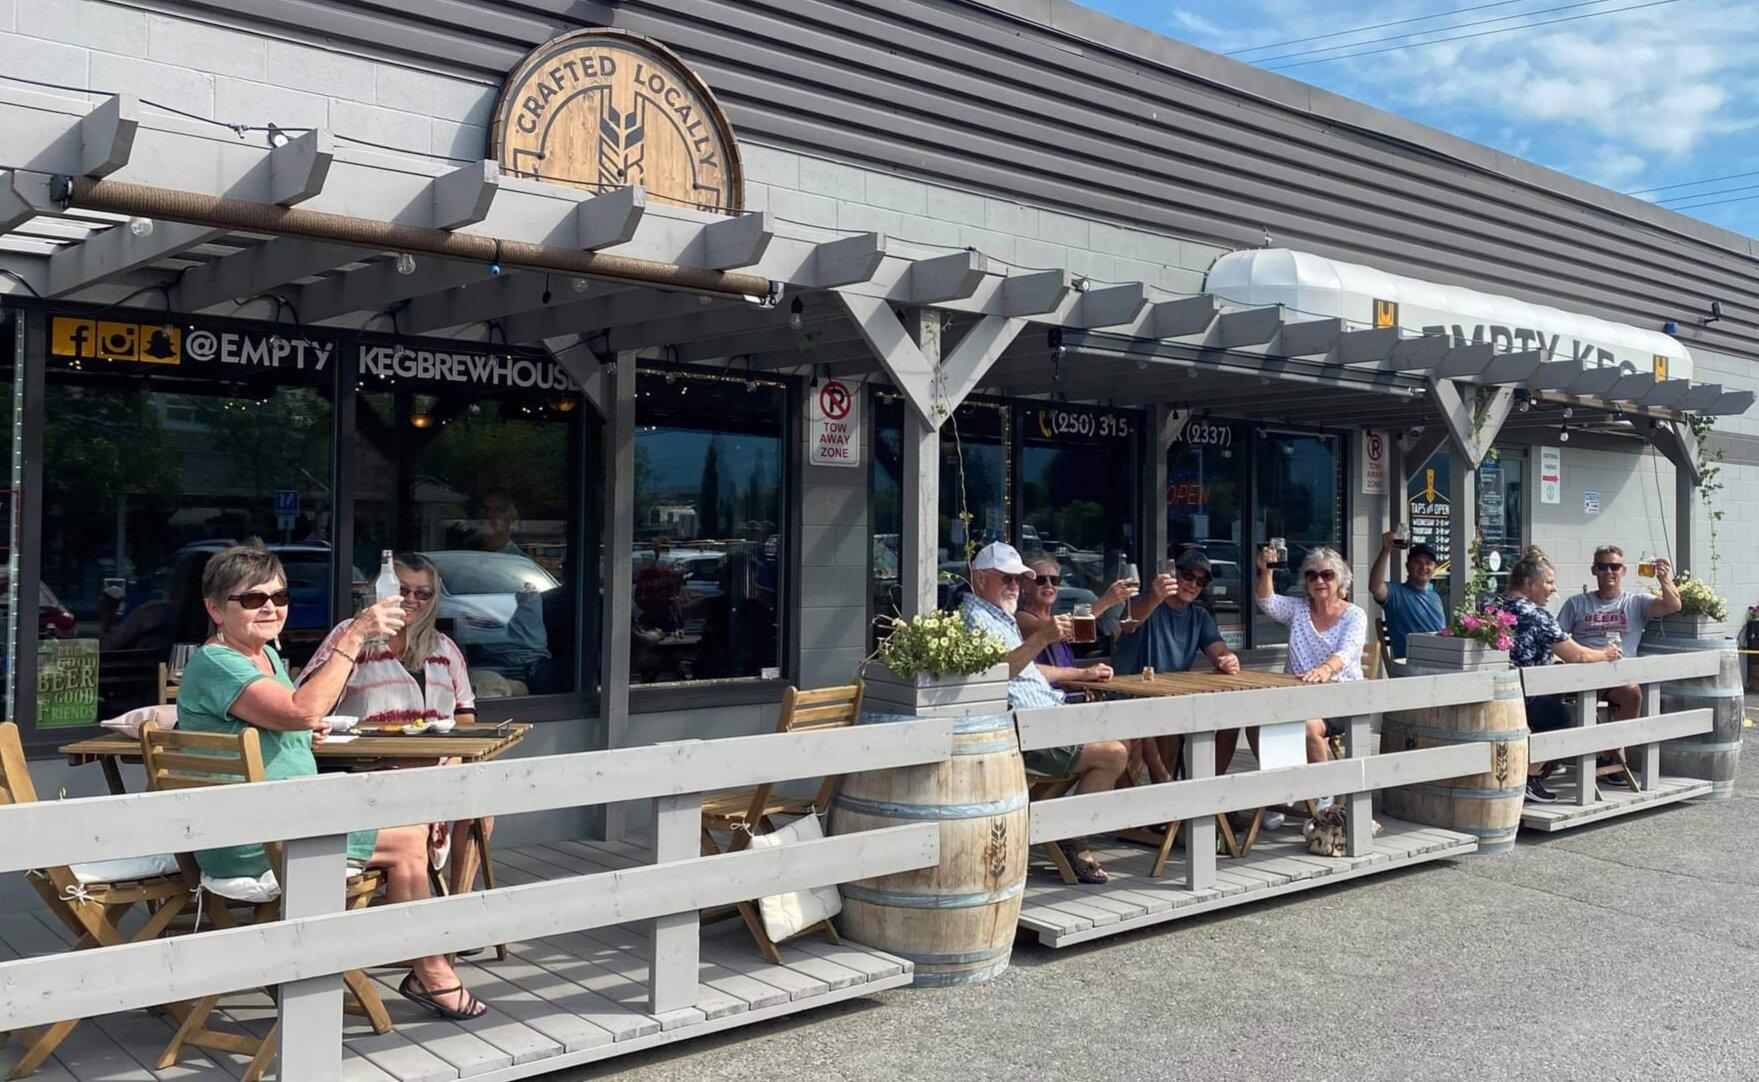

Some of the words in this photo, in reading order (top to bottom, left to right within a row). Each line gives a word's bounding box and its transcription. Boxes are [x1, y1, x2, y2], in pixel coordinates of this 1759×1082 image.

[516, 55, 617, 134] CRAFTED
[633, 63, 718, 170] LOCALLY
[186, 330, 334, 371] @EMPTY
[823, 422, 847, 433] TOW
[1051, 410, 1095, 437] (250)
[819, 433, 851, 445] AWAY
[1187, 422, 1232, 447] (2337)
[821, 447, 849, 458] ZONE
[1411, 502, 1426, 515] TAPS
[57, 657, 96, 671] GOOD
[39, 667, 95, 692] BEER
[54, 687, 95, 705] GOOD
[38, 699, 97, 721] FRIENDS
